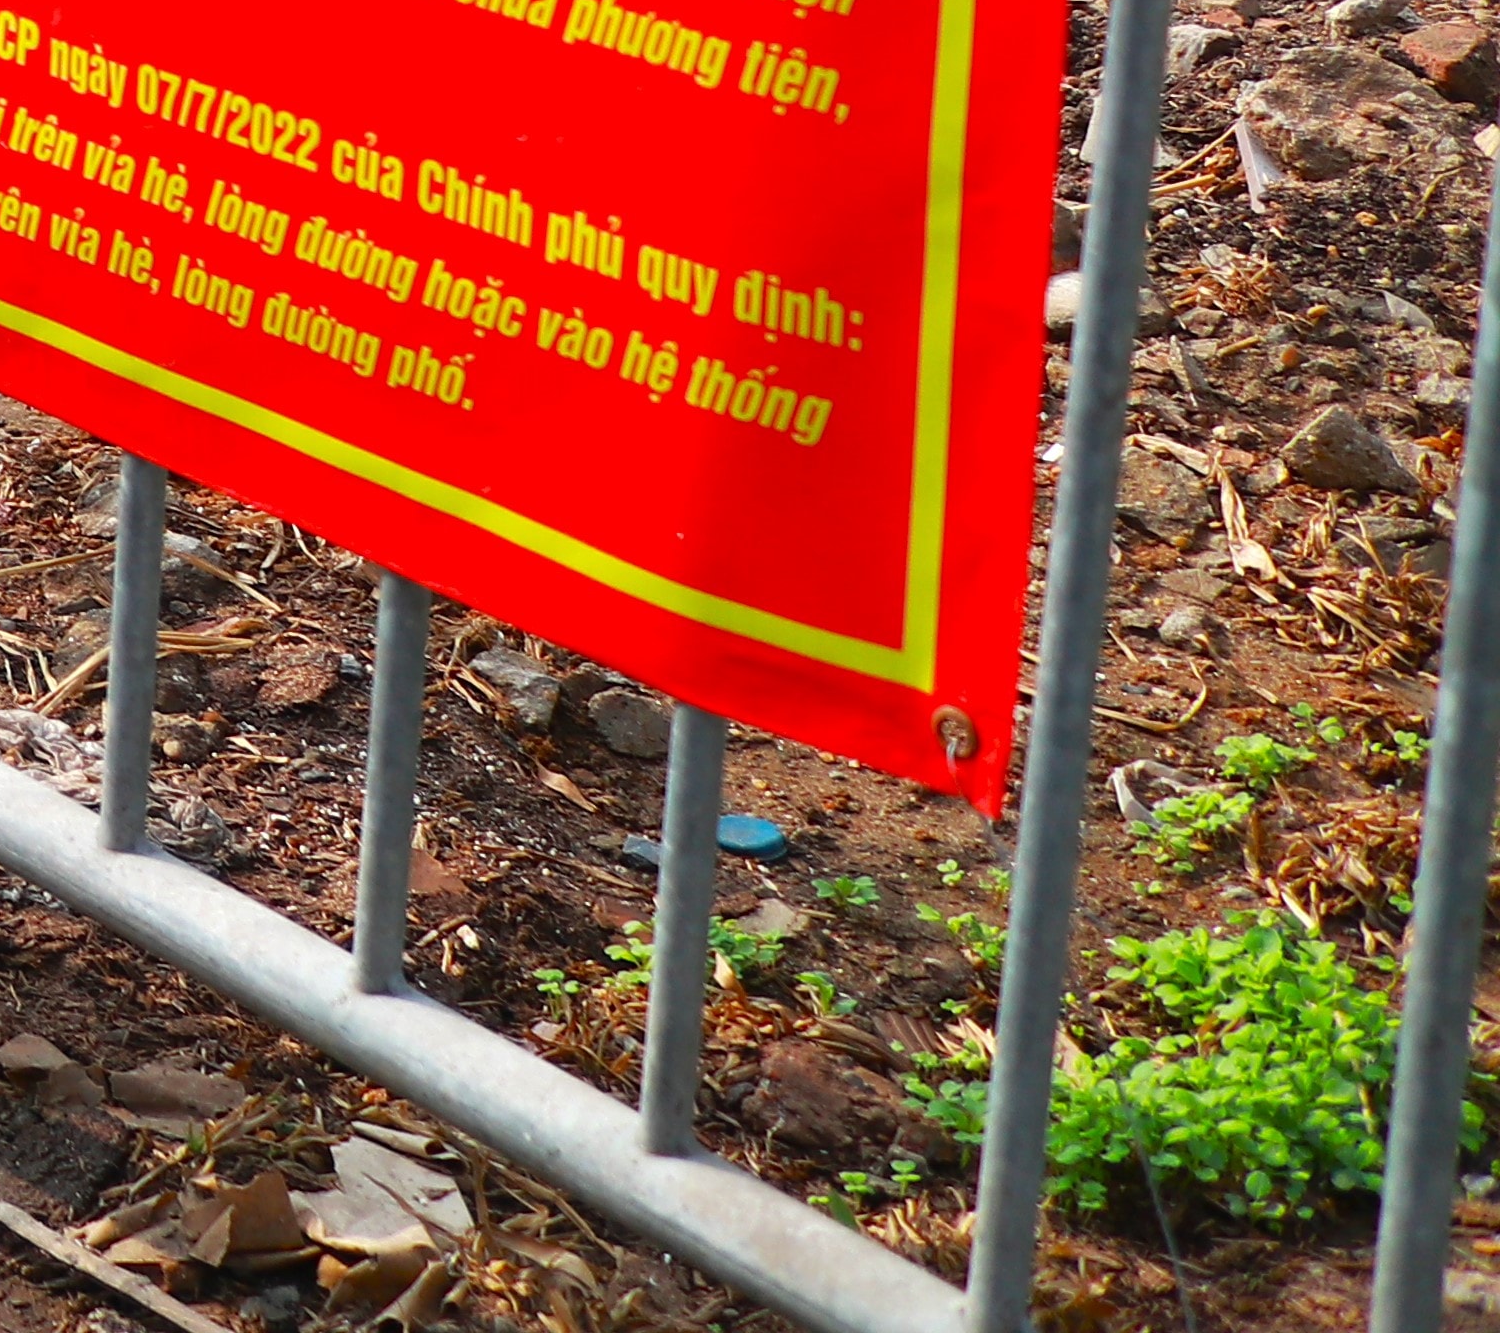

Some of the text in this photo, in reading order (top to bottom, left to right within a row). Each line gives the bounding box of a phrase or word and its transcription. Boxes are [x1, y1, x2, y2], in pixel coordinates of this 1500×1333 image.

[106, 227, 160, 294] hè,
[171, 252, 254, 328] lòng
[261, 290, 380, 377] đường
[386, 343, 474, 410] phố.
